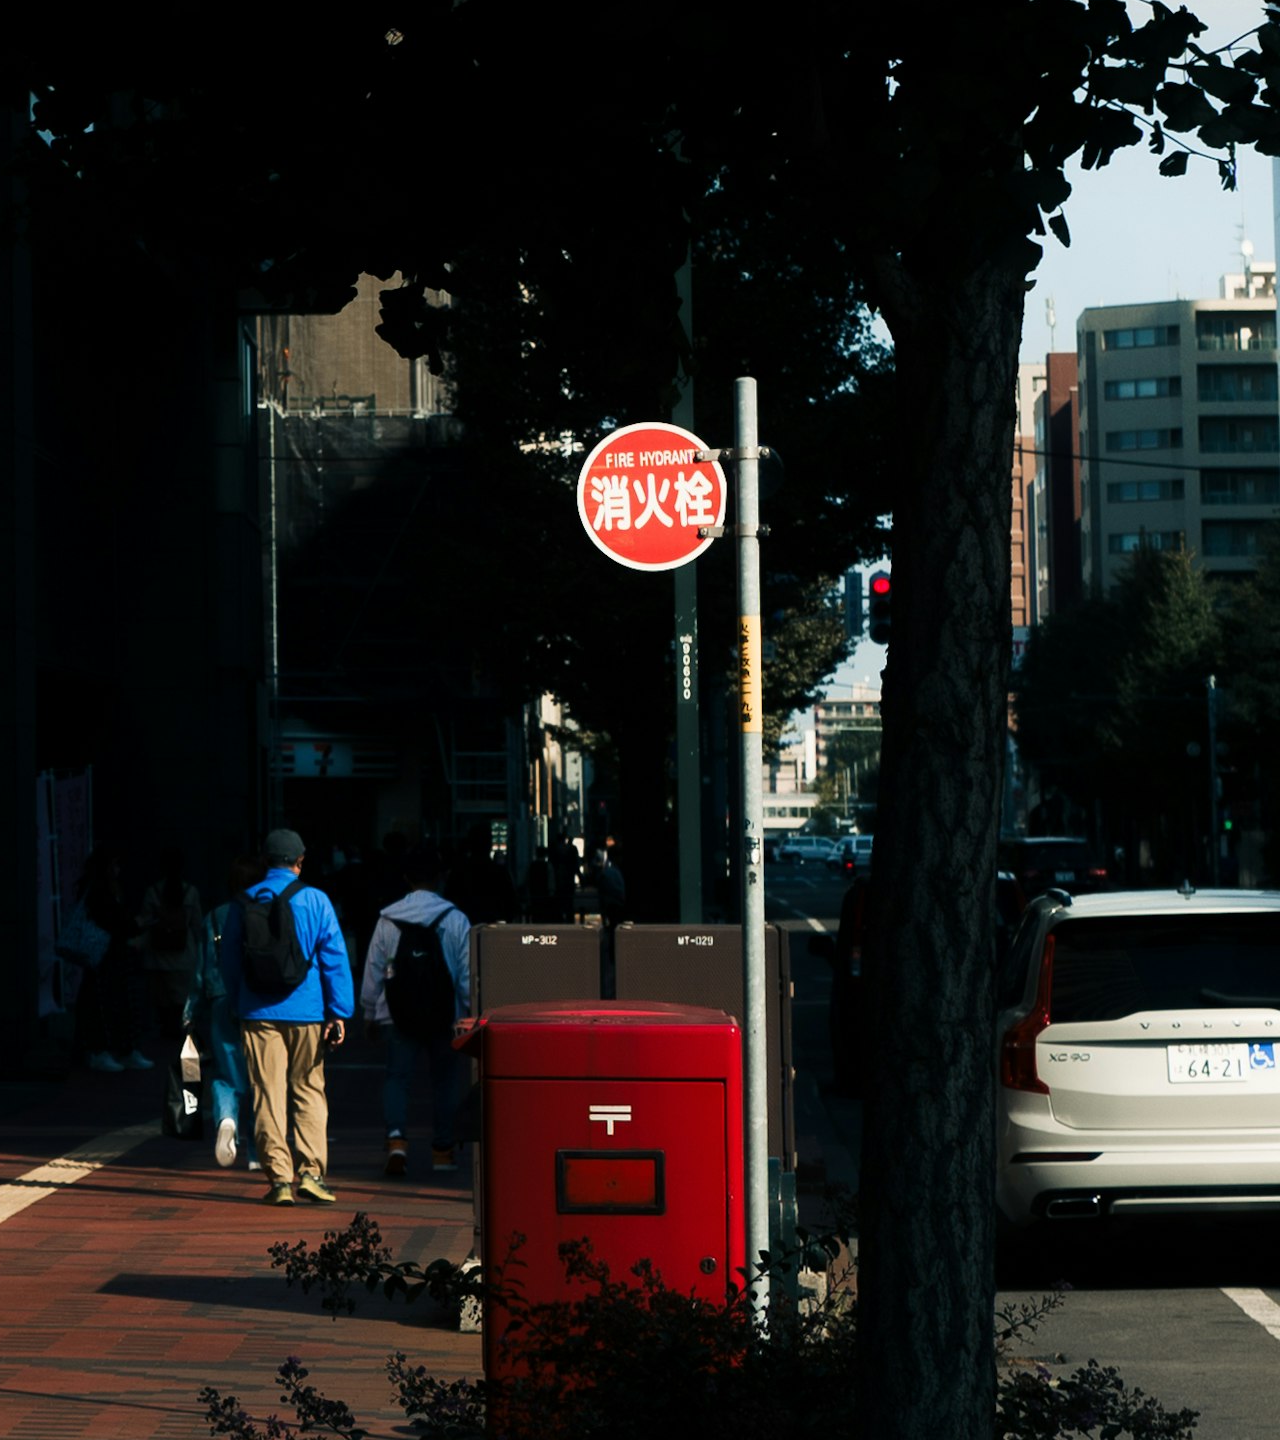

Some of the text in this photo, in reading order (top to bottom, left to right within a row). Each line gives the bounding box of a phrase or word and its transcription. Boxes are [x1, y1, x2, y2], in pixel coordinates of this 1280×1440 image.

[605, 448, 697, 469] FIRE HYDRANT
[590, 470, 715, 532] 消火栓
[1139, 1020, 1273, 1030] VOLVO
[1187, 1058, 1243, 1078] 64-21
